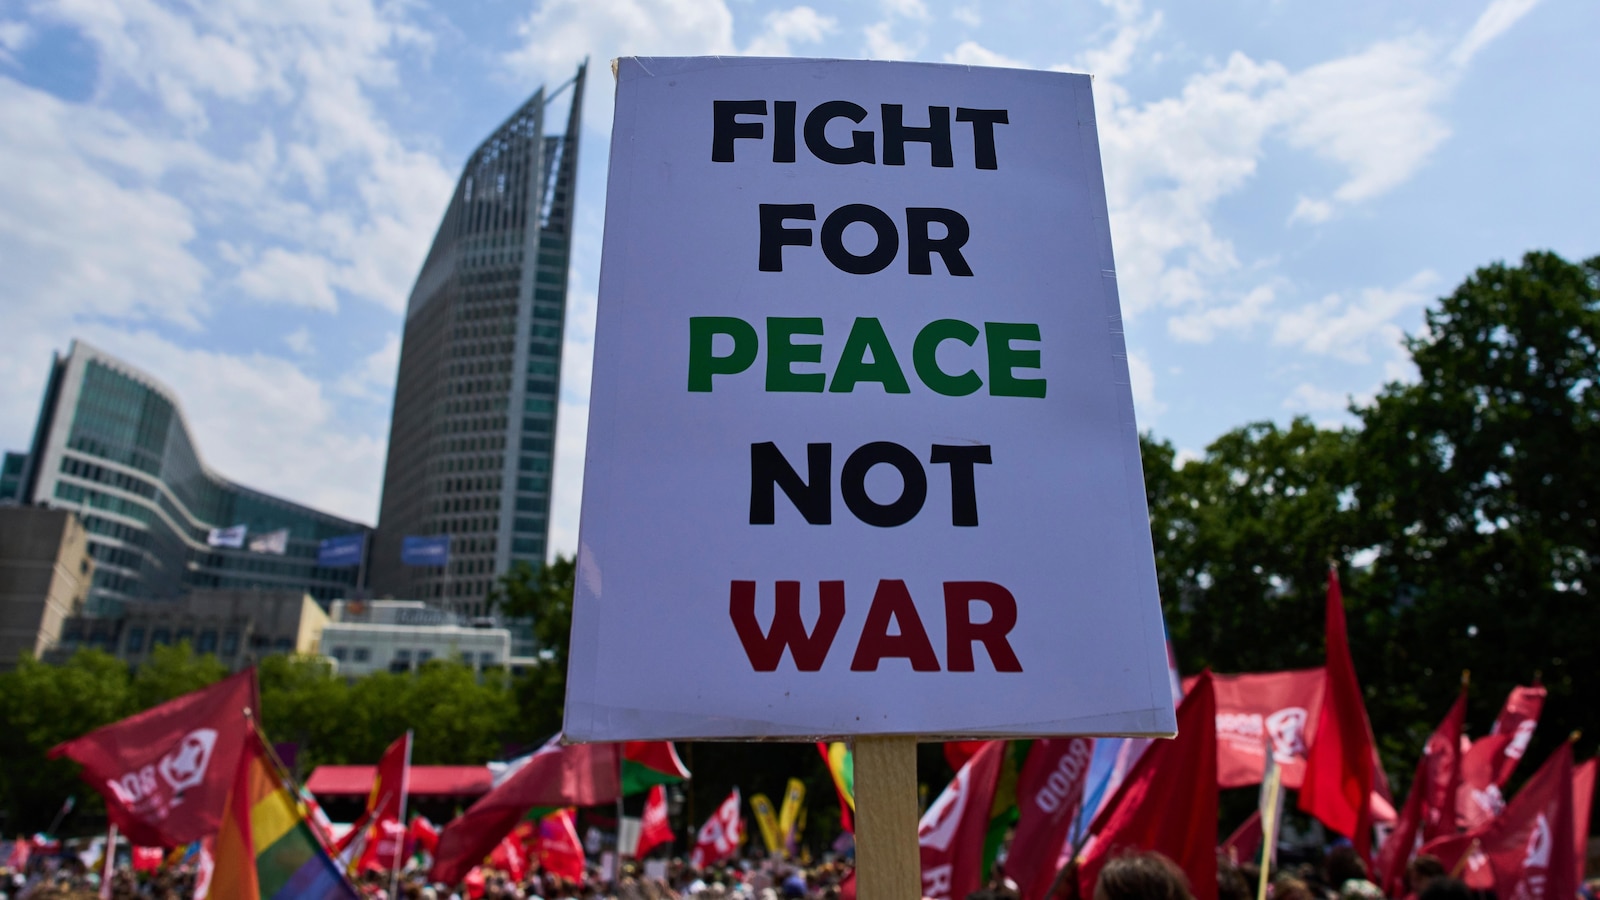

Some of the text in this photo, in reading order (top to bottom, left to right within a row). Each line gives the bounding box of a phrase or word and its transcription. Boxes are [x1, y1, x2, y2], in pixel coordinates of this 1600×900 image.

[711, 99, 1010, 170] FIGHT
[758, 203, 974, 277] FOR
[687, 316, 1048, 399] PEACE
[749, 440, 993, 527] NOT
[729, 578, 1024, 673] WAR
